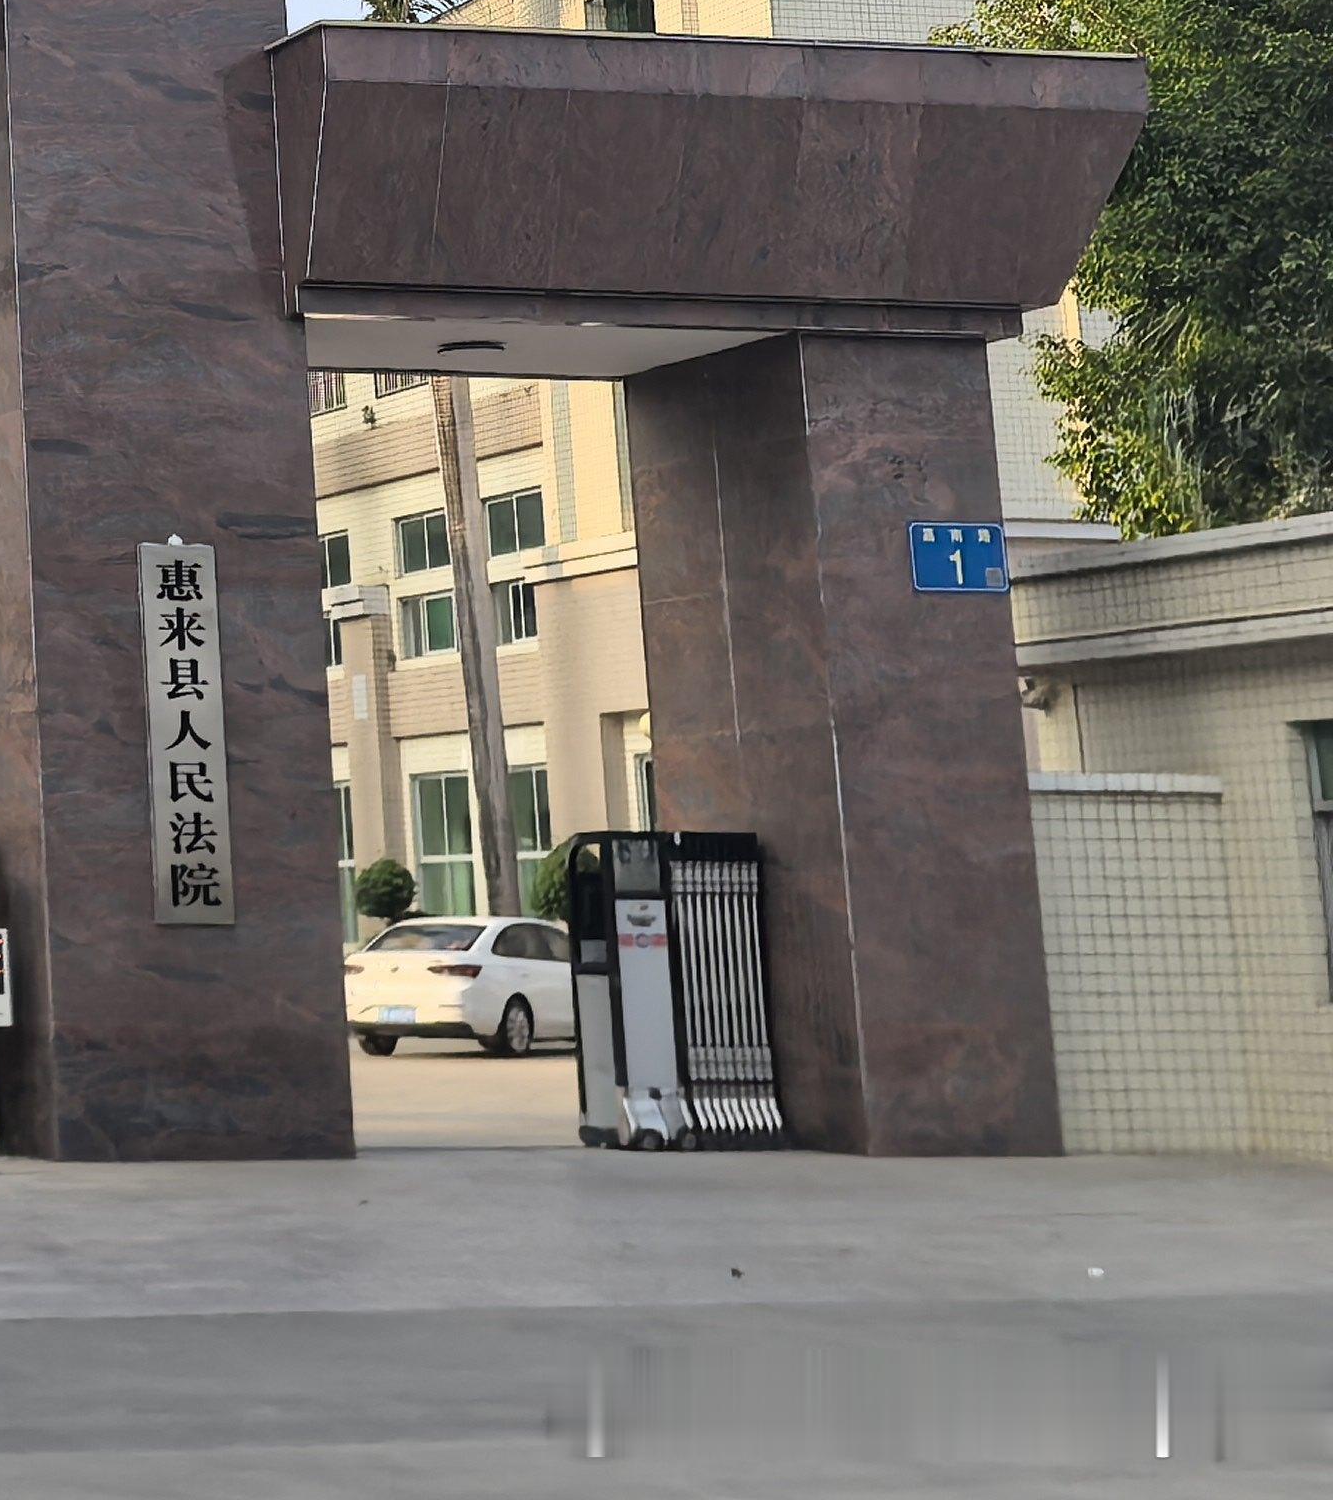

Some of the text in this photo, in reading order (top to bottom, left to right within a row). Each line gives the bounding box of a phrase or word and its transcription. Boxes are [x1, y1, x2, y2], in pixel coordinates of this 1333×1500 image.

[949, 549, 963, 585] 1
[155, 559, 222, 908] 惠来县人民法院
